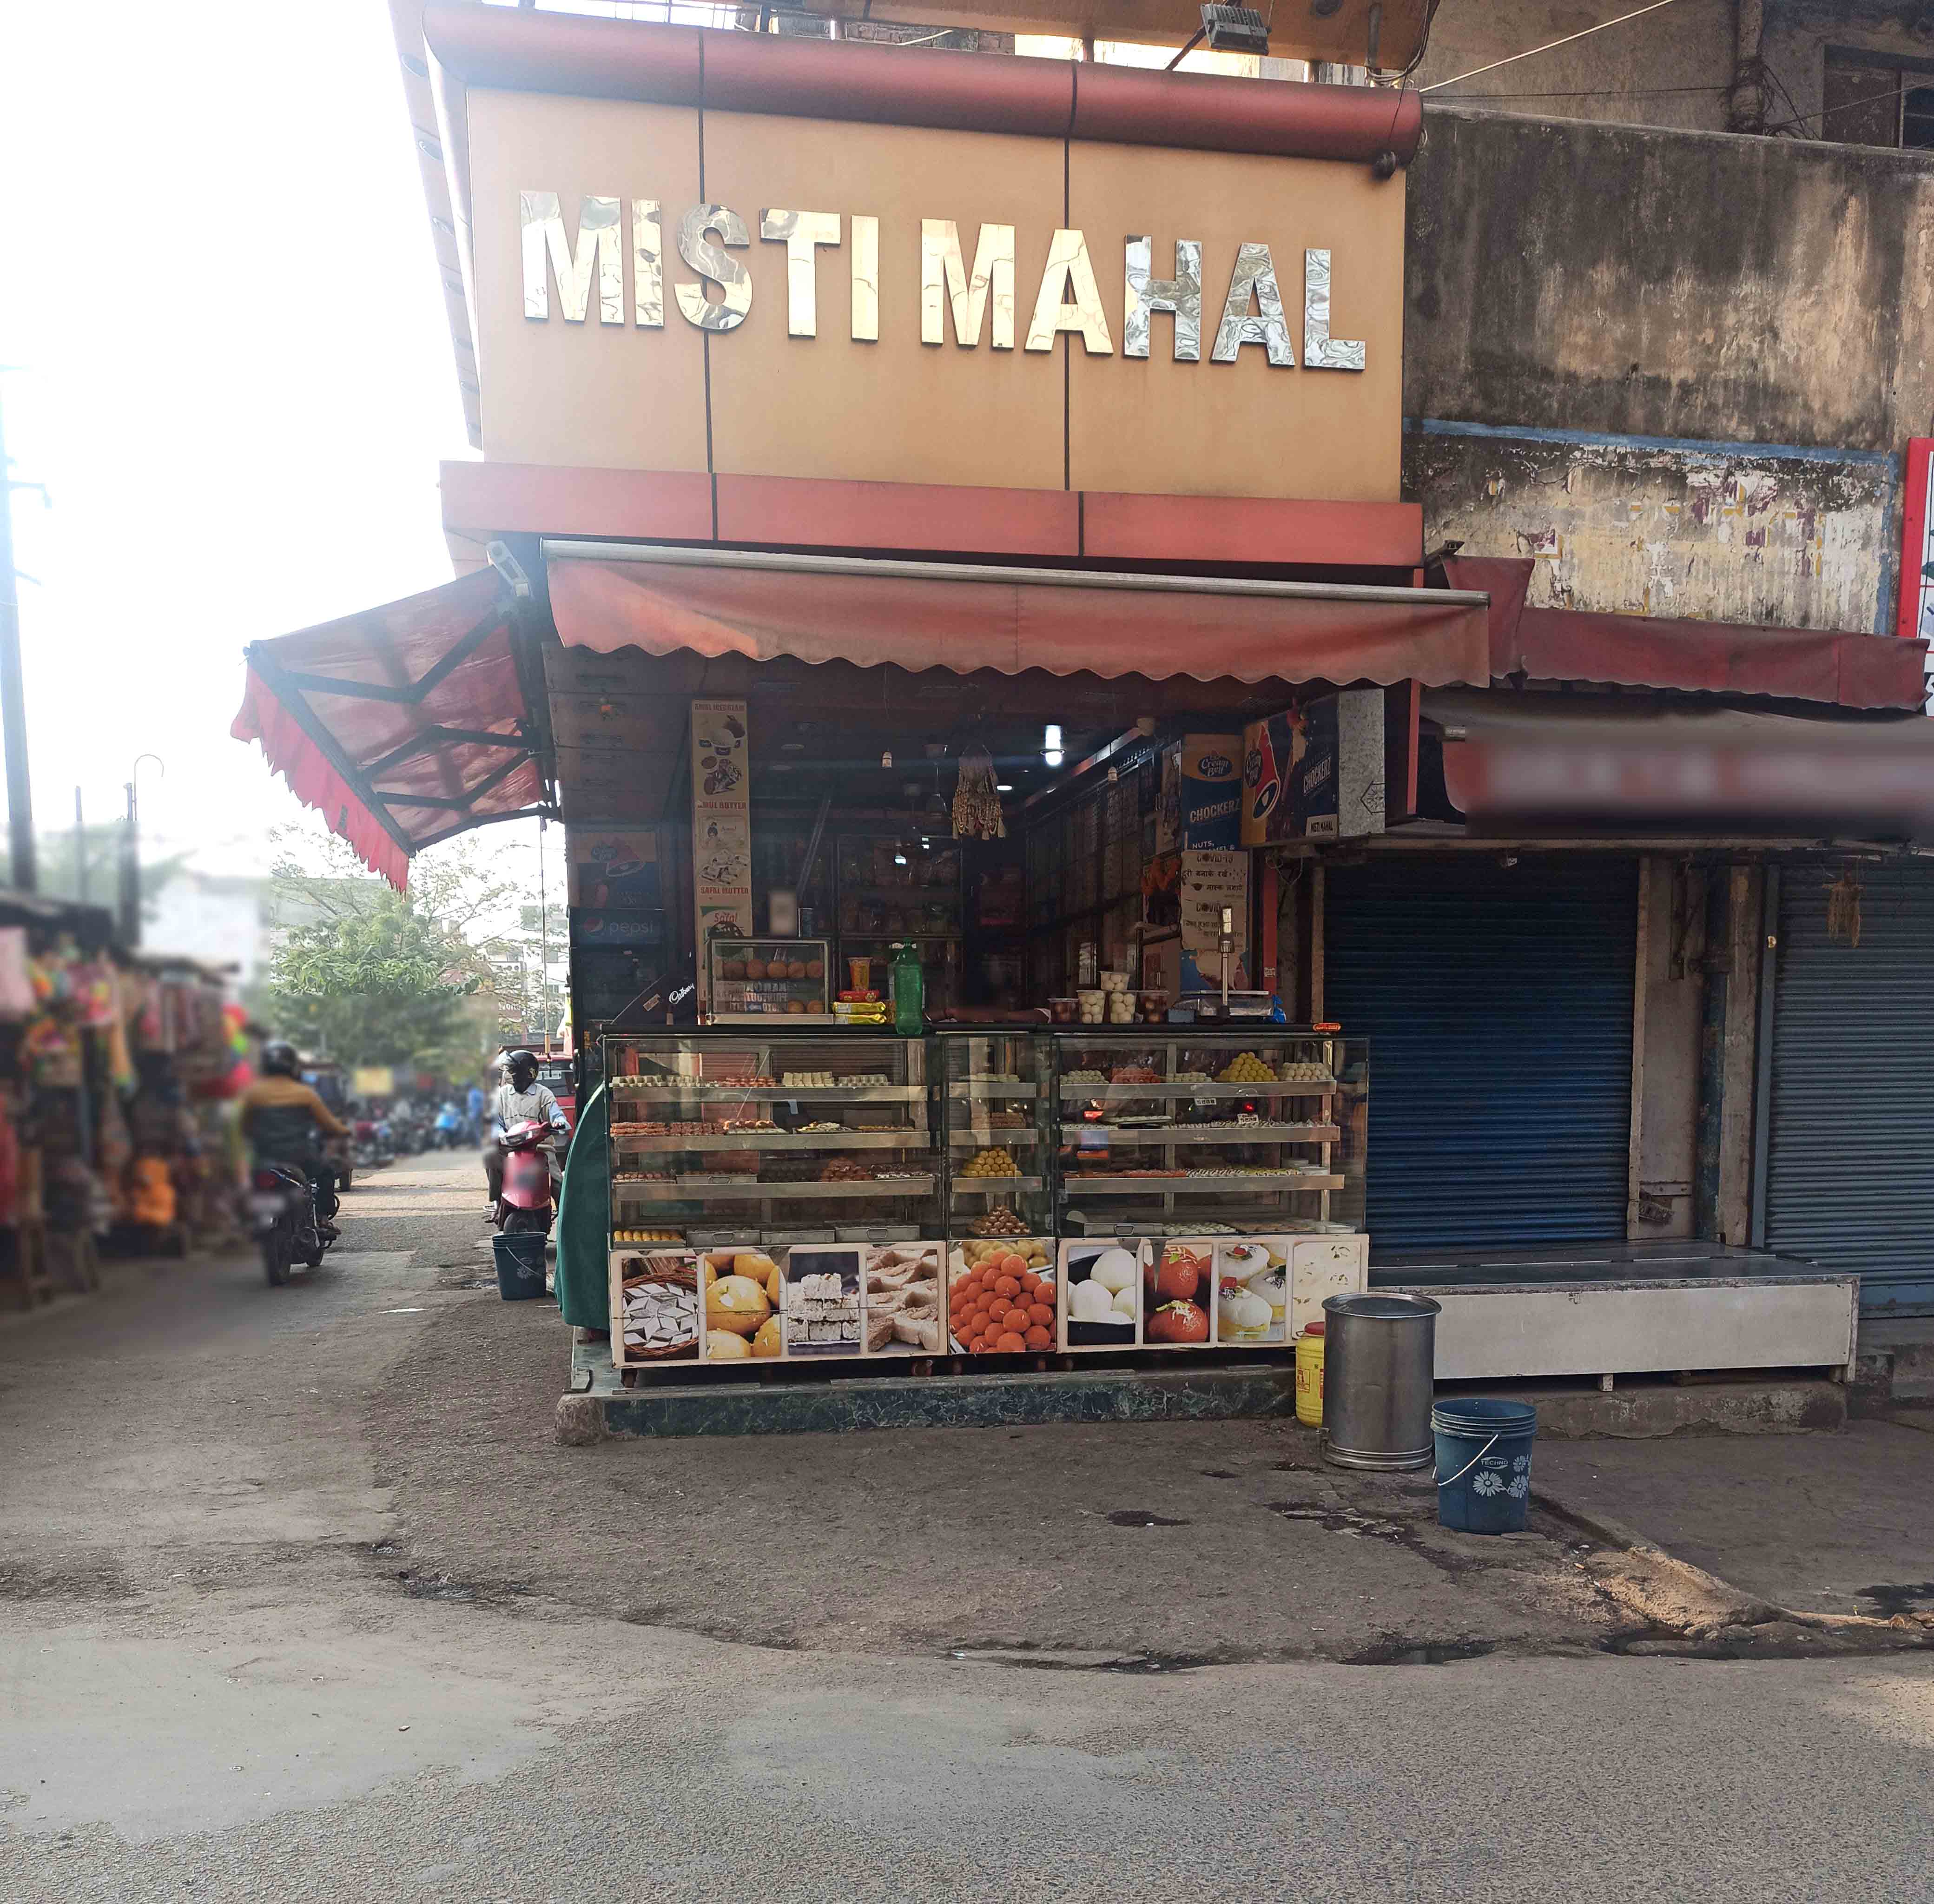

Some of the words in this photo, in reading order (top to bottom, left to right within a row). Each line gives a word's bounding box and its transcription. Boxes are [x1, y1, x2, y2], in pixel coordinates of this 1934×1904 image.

[520, 190, 880, 343] MISTI
[920, 217, 1366, 371] MAHAL
[1189, 798, 1241, 823] CHOCKERZ
[609, 921, 653, 937] pepsi
[668, 982, 695, 1005] Cadbury
